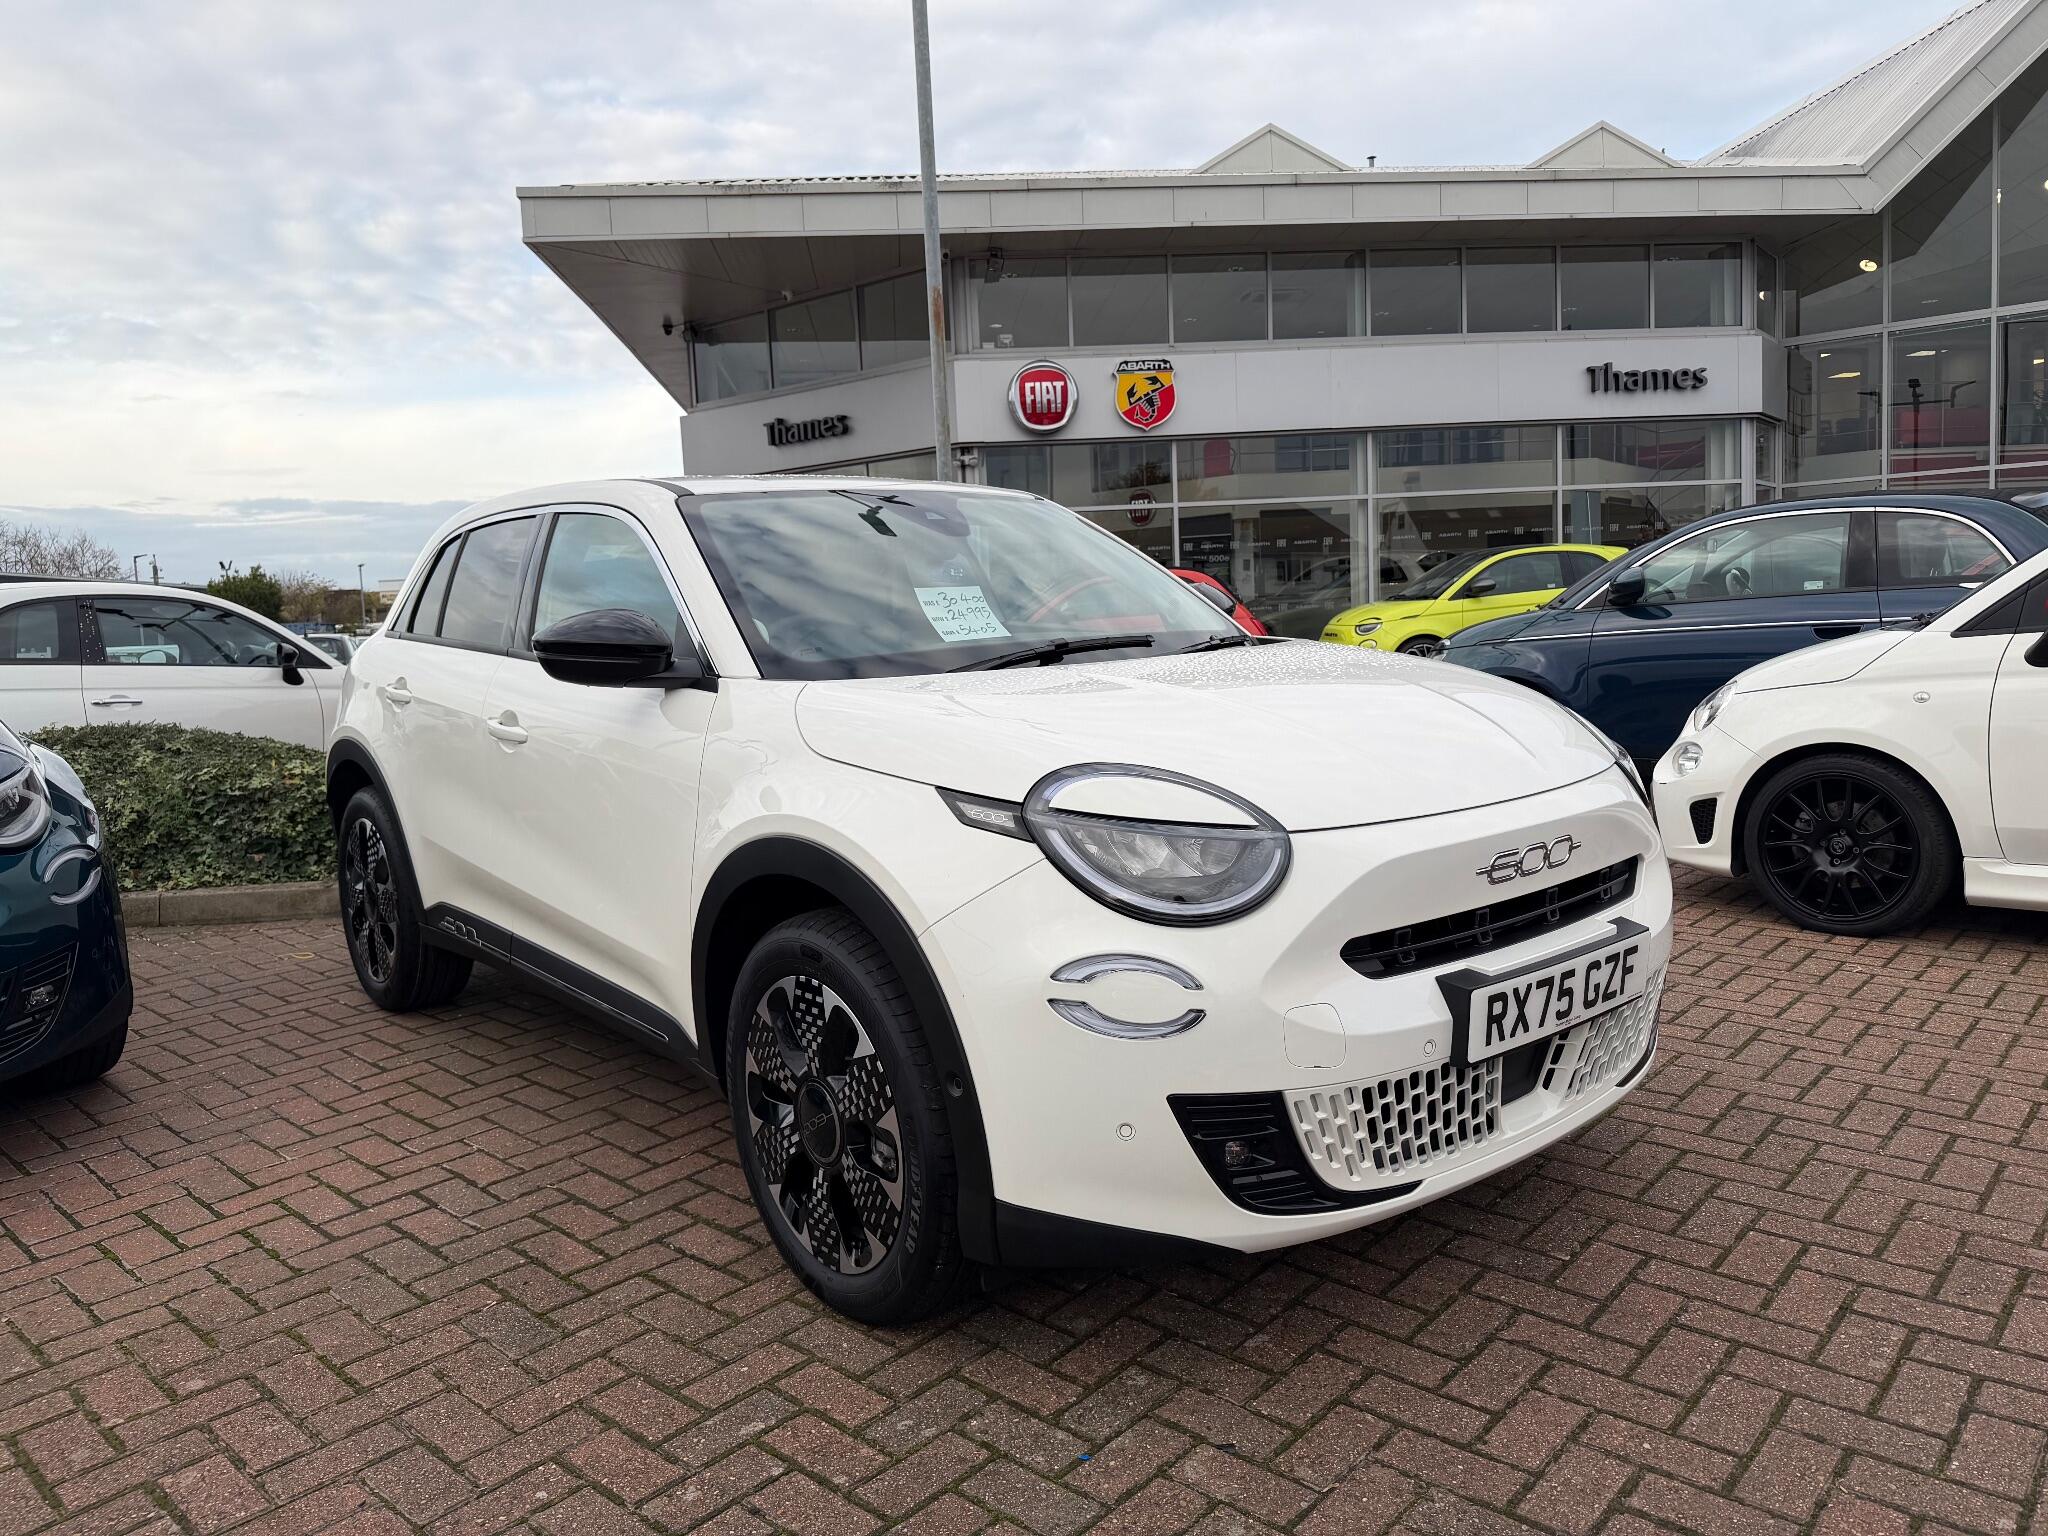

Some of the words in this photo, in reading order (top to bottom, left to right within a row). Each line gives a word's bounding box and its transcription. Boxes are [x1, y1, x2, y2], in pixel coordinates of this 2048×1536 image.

[1119, 361, 1170, 371] ABARTH
[1586, 362, 1709, 393] Thames
[1024, 381, 1065, 414] FIAT
[763, 415, 849, 447] Thames
[970, 808, 1005, 822] 600
[1483, 834, 1575, 885] 600
[1485, 968, 1576, 1047] RX75
[1582, 945, 1639, 1010] GZF
